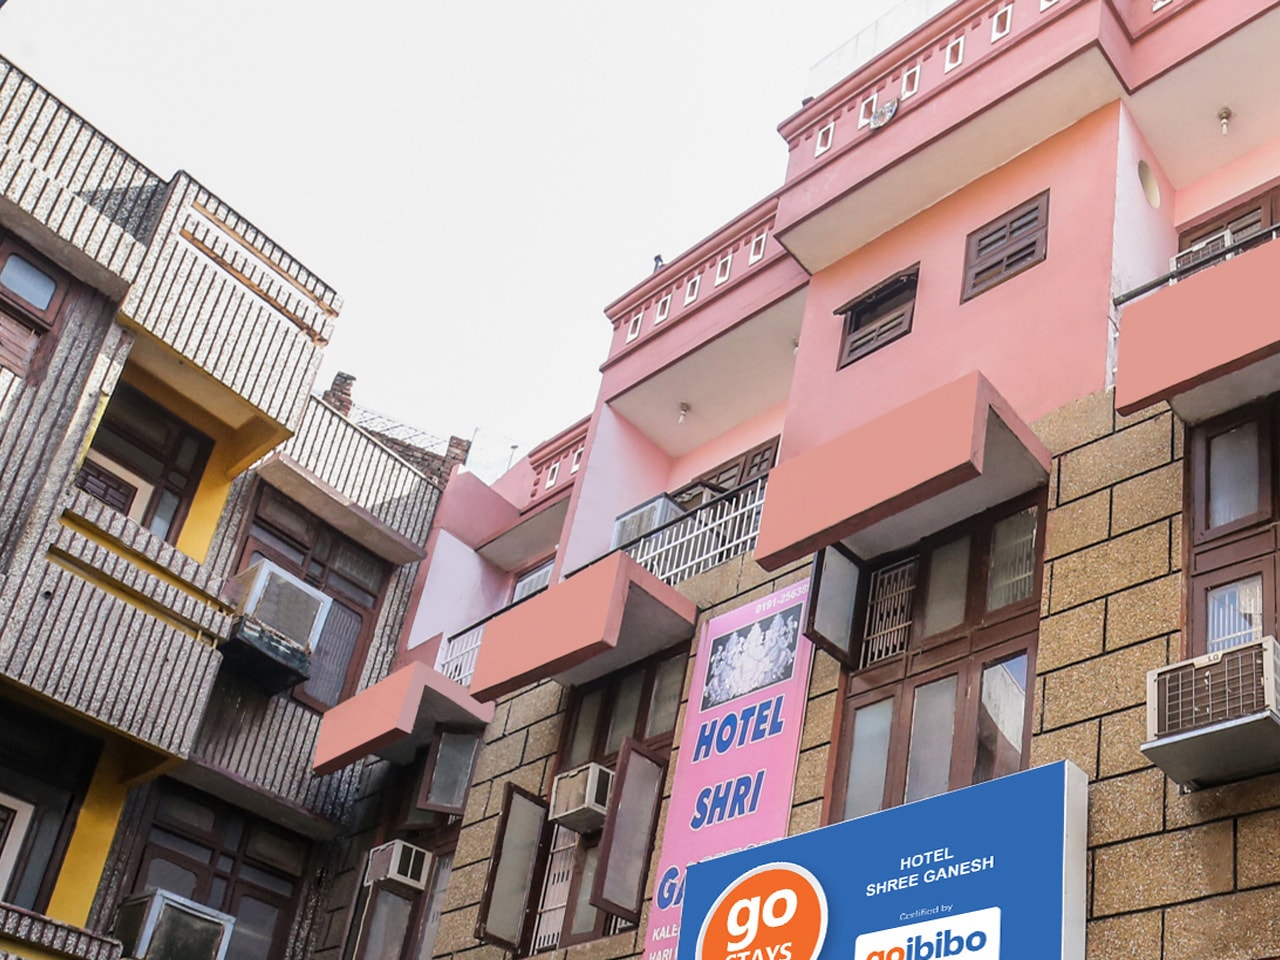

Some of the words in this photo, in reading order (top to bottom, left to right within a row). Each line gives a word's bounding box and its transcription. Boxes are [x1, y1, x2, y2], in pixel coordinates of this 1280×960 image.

[755, 584, 809, 614] 0191-25638
[691, 693, 785, 764] HOTEL
[689, 768, 767, 832] SHRI
[865, 873, 919, 897] SHREE
[923, 855, 994, 883] GANESH
[900, 847, 954, 871] HOTEL
[726, 888, 798, 952] go
[899, 905, 939, 921] Certified
[941, 904, 953, 913] by
[651, 923, 681, 942] KALE
